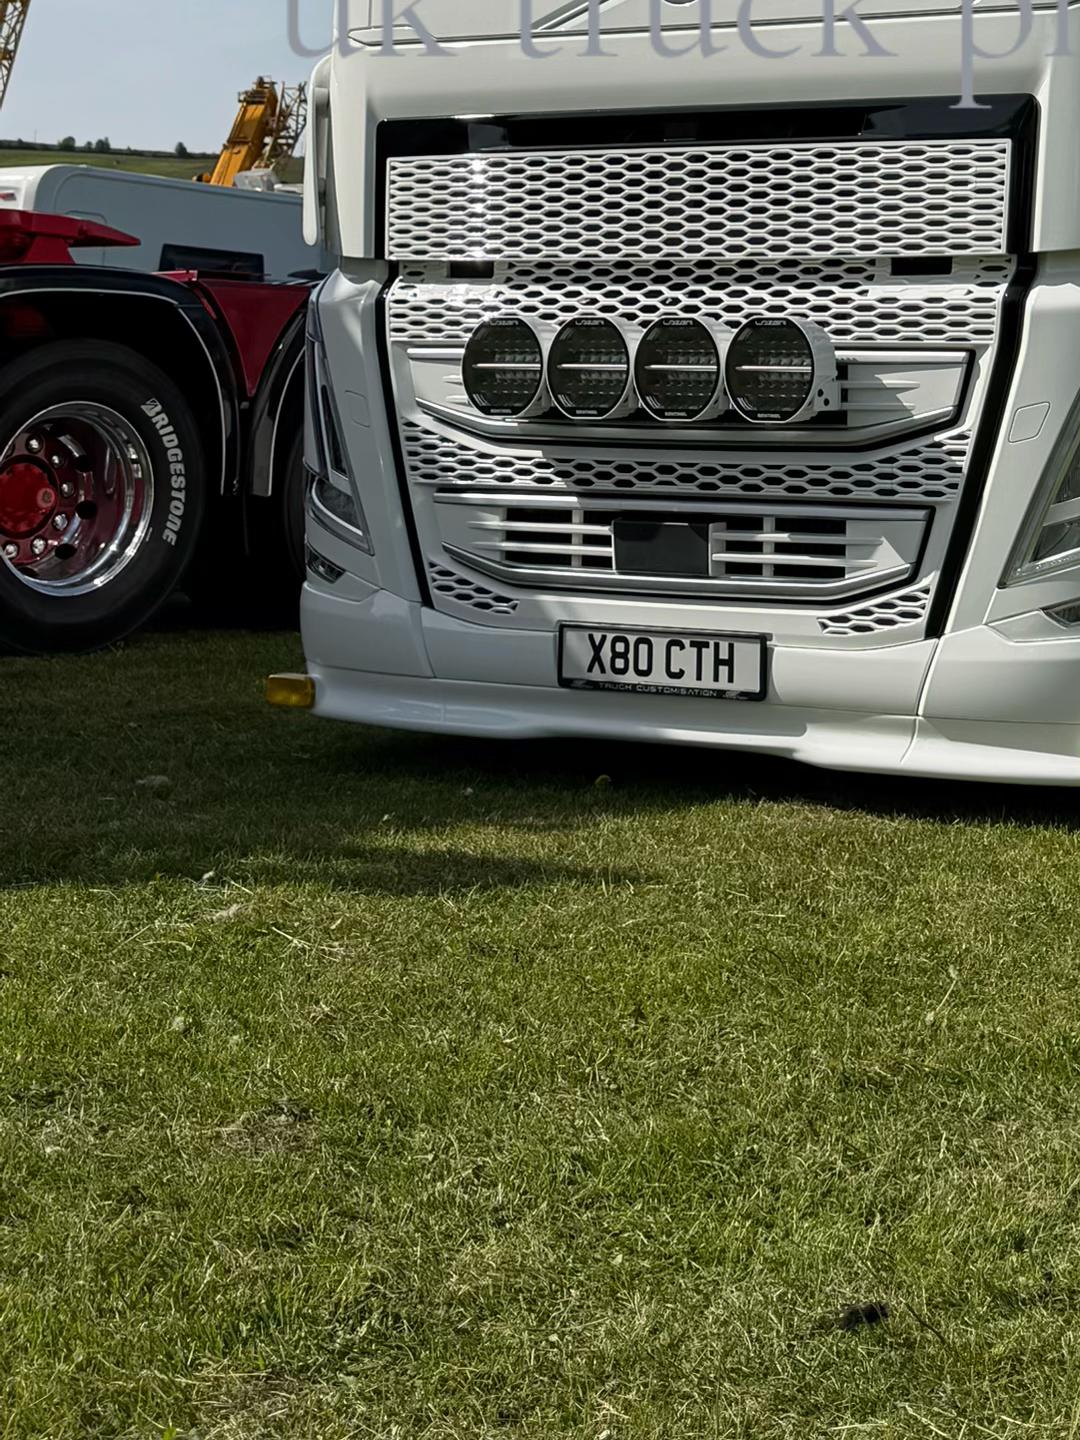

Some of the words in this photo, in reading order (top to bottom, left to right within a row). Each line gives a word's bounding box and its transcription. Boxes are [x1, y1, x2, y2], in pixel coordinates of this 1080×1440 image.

[140, 397, 187, 547] BRIDGESTONE
[586, 632, 654, 678] X80
[665, 638, 735, 684] CTH
[598, 682, 632, 691] TRUCK
[636, 684, 718, 697] CUSTOMISATION
